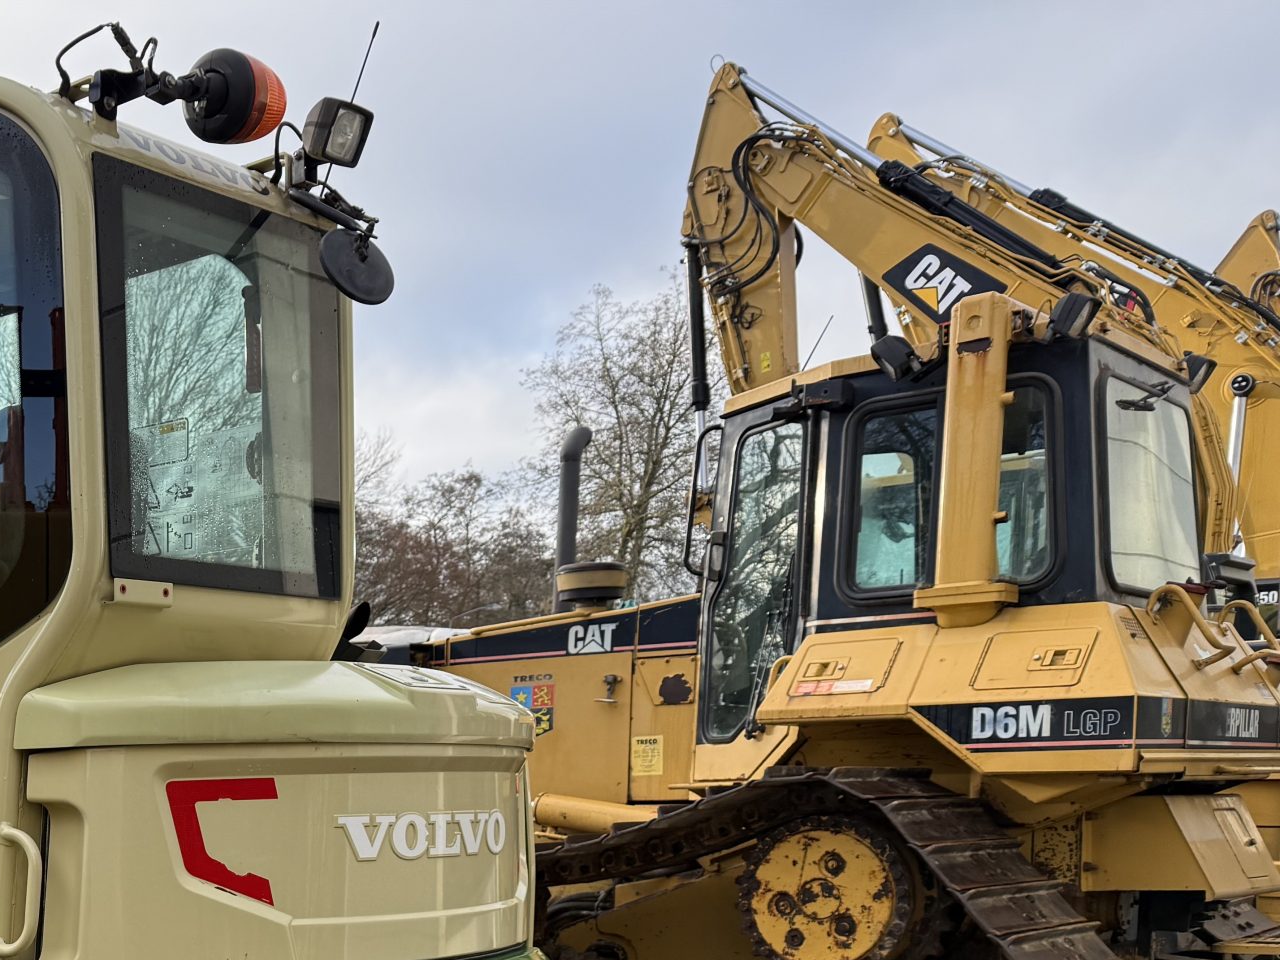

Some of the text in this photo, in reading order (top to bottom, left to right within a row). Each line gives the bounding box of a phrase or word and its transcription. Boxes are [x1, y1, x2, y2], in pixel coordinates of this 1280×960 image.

[121, 127, 270, 195] VOLVO
[904, 254, 973, 315] CAT
[1254, 590, 1278, 605] 50
[567, 622, 619, 655] CAT
[513, 673, 553, 682] TRECO
[972, 704, 1121, 739] D6M LGP
[334, 808, 507, 861] VOLVO
